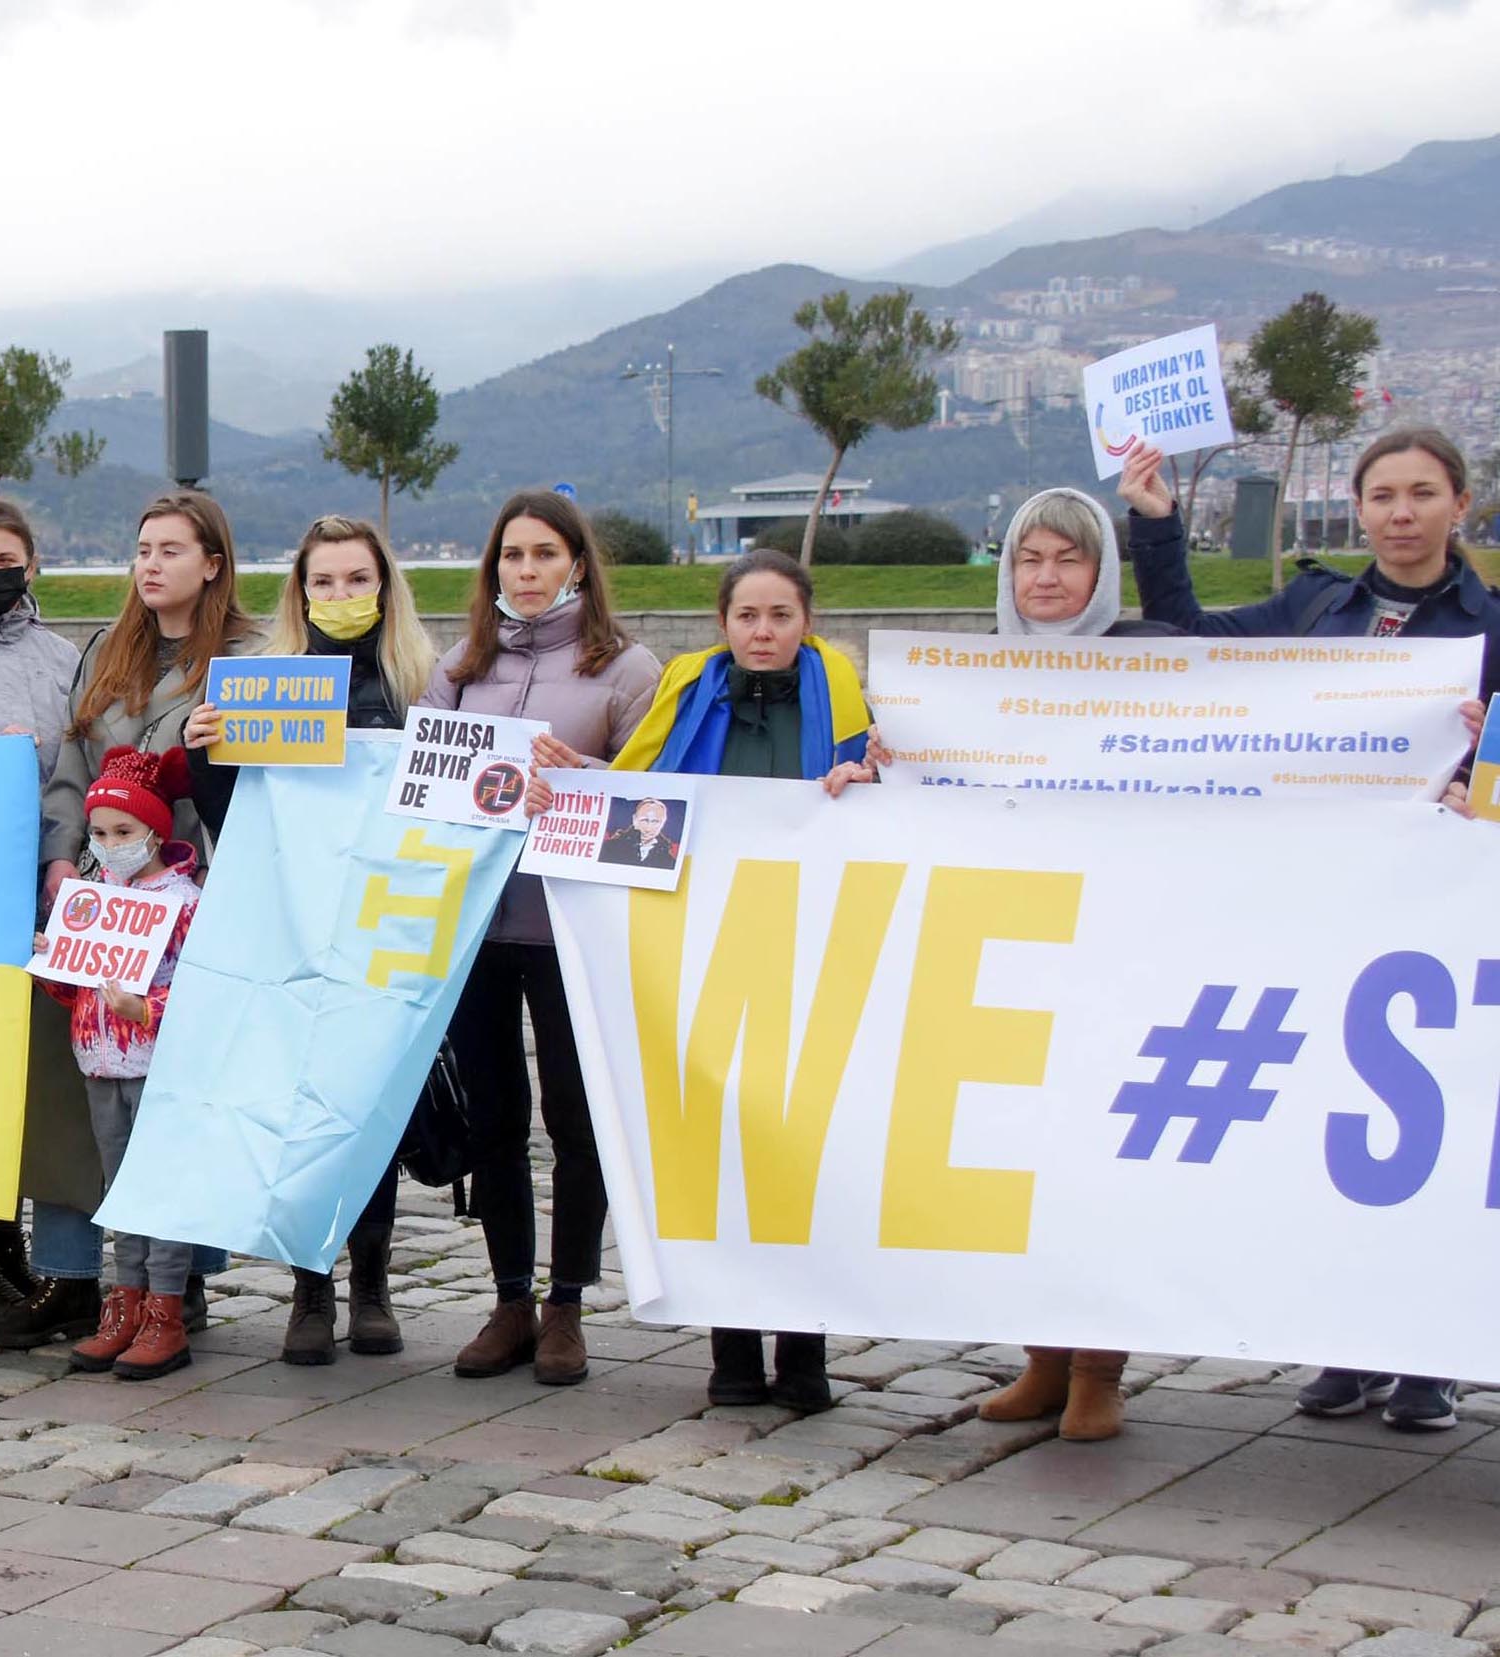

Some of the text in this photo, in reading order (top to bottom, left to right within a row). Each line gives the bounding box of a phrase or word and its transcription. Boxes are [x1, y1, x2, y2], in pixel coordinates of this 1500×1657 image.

[1113, 349, 1206, 395] UKRAYNA'YA
[1125, 376, 1209, 416] DESTEK OL
[1141, 402, 1214, 436] TÜRKİYE
[907, 646, 1190, 673] #StandWithUkraine
[1206, 647, 1412, 664] #StandWithUkraine
[219, 676, 335, 702] STOP PUTIN
[997, 697, 1249, 718] #StandWithUkraine
[225, 718, 326, 744] STOP WAR
[415, 717, 495, 758] SAVAŞA
[1100, 732, 1411, 754] #StandWithUkraine
[408, 749, 472, 781] HAYIR
[891, 747, 1048, 766] tandWithUkraine
[920, 775, 1262, 797] #StdWithUkraine
[1271, 773, 1429, 788] #StandWithUkraine
[399, 781, 430, 809] DE
[553, 790, 605, 816] UTİN'İ
[538, 815, 600, 837] DURDUR
[532, 833, 595, 858] TÜRKİYE
[101, 896, 168, 937] STOP
[48, 936, 150, 983] RUSSIA
[628, 855, 1500, 1255] WE #S
